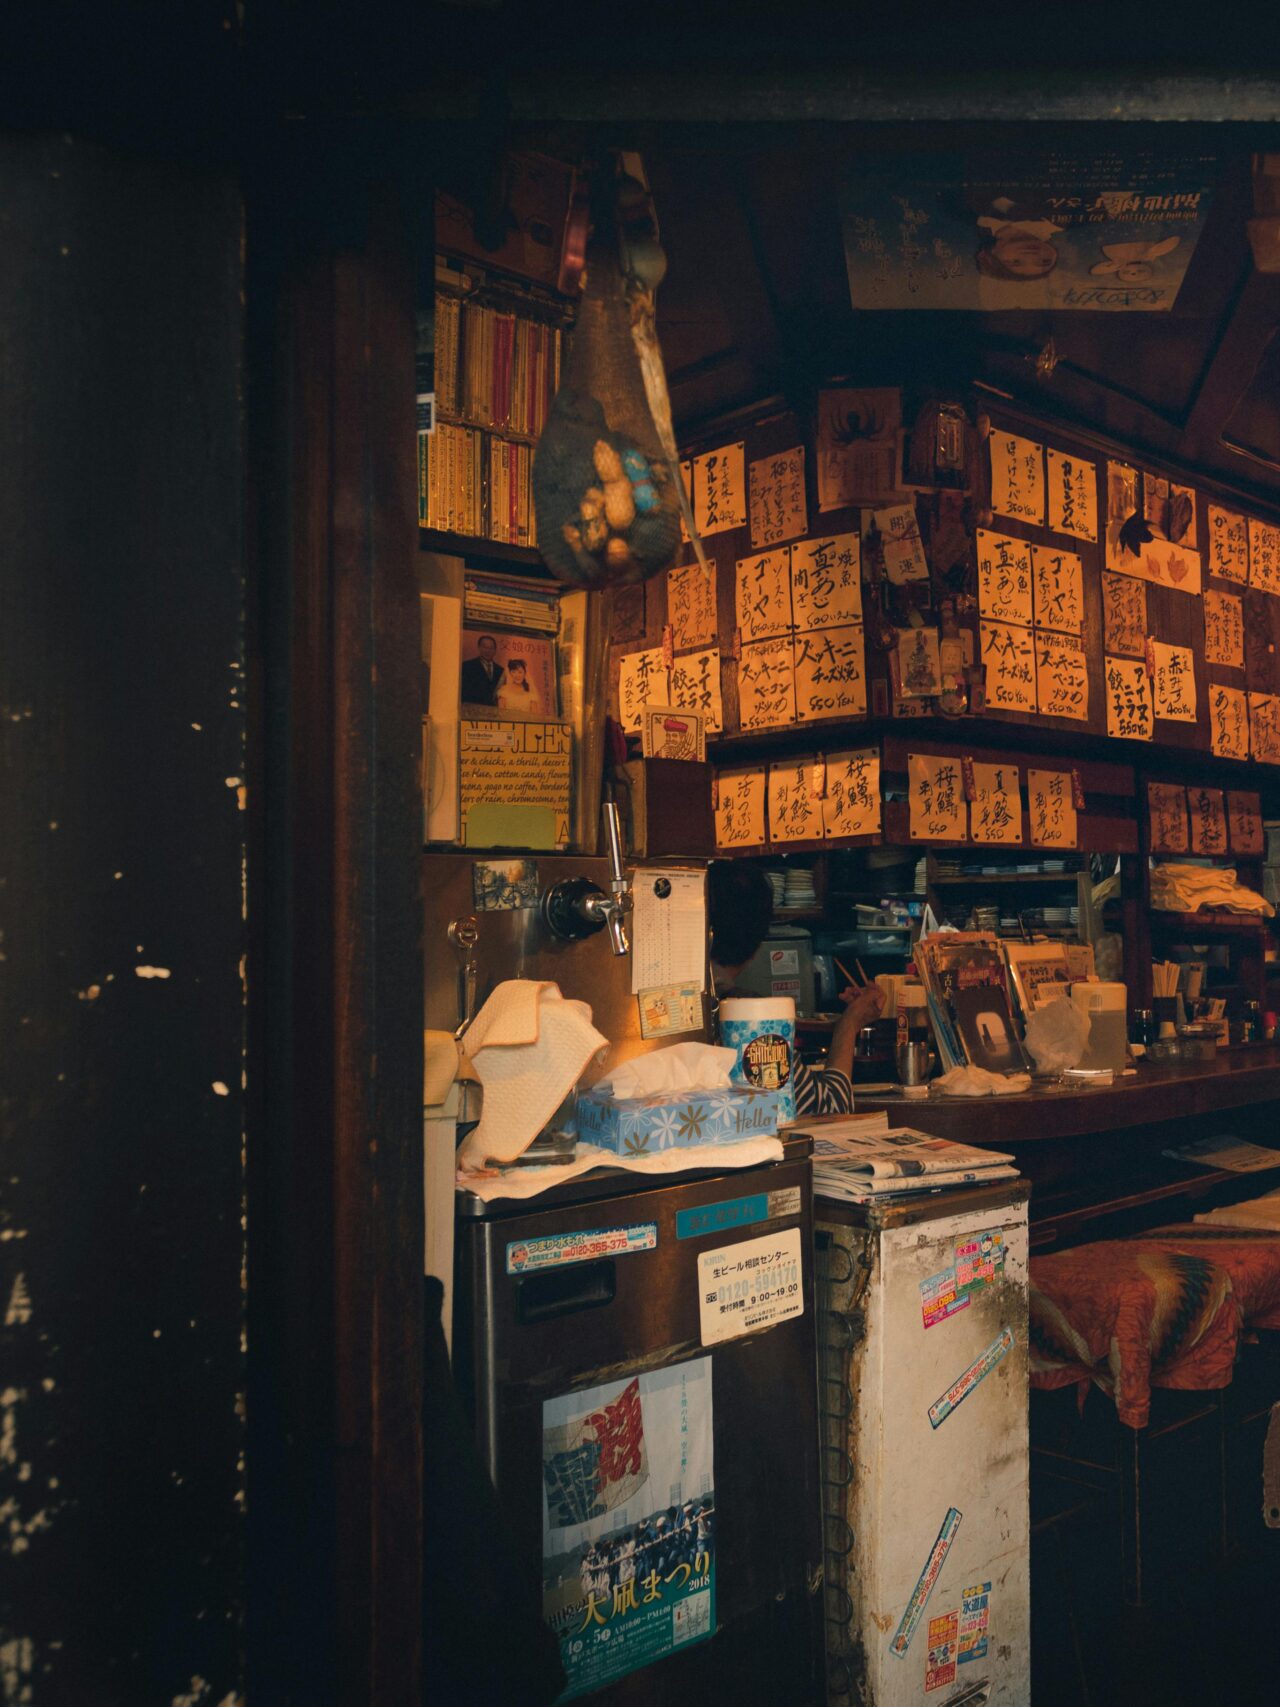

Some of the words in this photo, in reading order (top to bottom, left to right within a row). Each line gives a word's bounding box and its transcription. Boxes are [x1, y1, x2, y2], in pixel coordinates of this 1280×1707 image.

[754, 557, 771, 618] ゴーヤ
[1049, 556, 1067, 613] ゴーヤ
[796, 637, 858, 669] ズッキーニ
[985, 629, 1033, 660] ズッキーニ
[741, 660, 791, 685] ズッキーニ
[811, 660, 861, 685] チーズ焼
[998, 660, 1034, 685] チーズ焼
[1039, 650, 1085, 672] ズッキーニ
[754, 682, 793, 698] ベーコン
[1052, 673, 1086, 689] ベーコン
[776, 785, 789, 825] 刺身
[831, 779, 846, 821] 刺身
[784, 825, 806, 839] 550
[840, 818, 862, 834] 550
[928, 821, 947, 834] 550
[985, 825, 1005, 840] 550
[736, 1107, 771, 1135] Hello
[713, 1250, 790, 1279] 生ビール相談センター
[718, 1265, 798, 1304] 0120-594170
[689, 1574, 711, 1592] 2018
